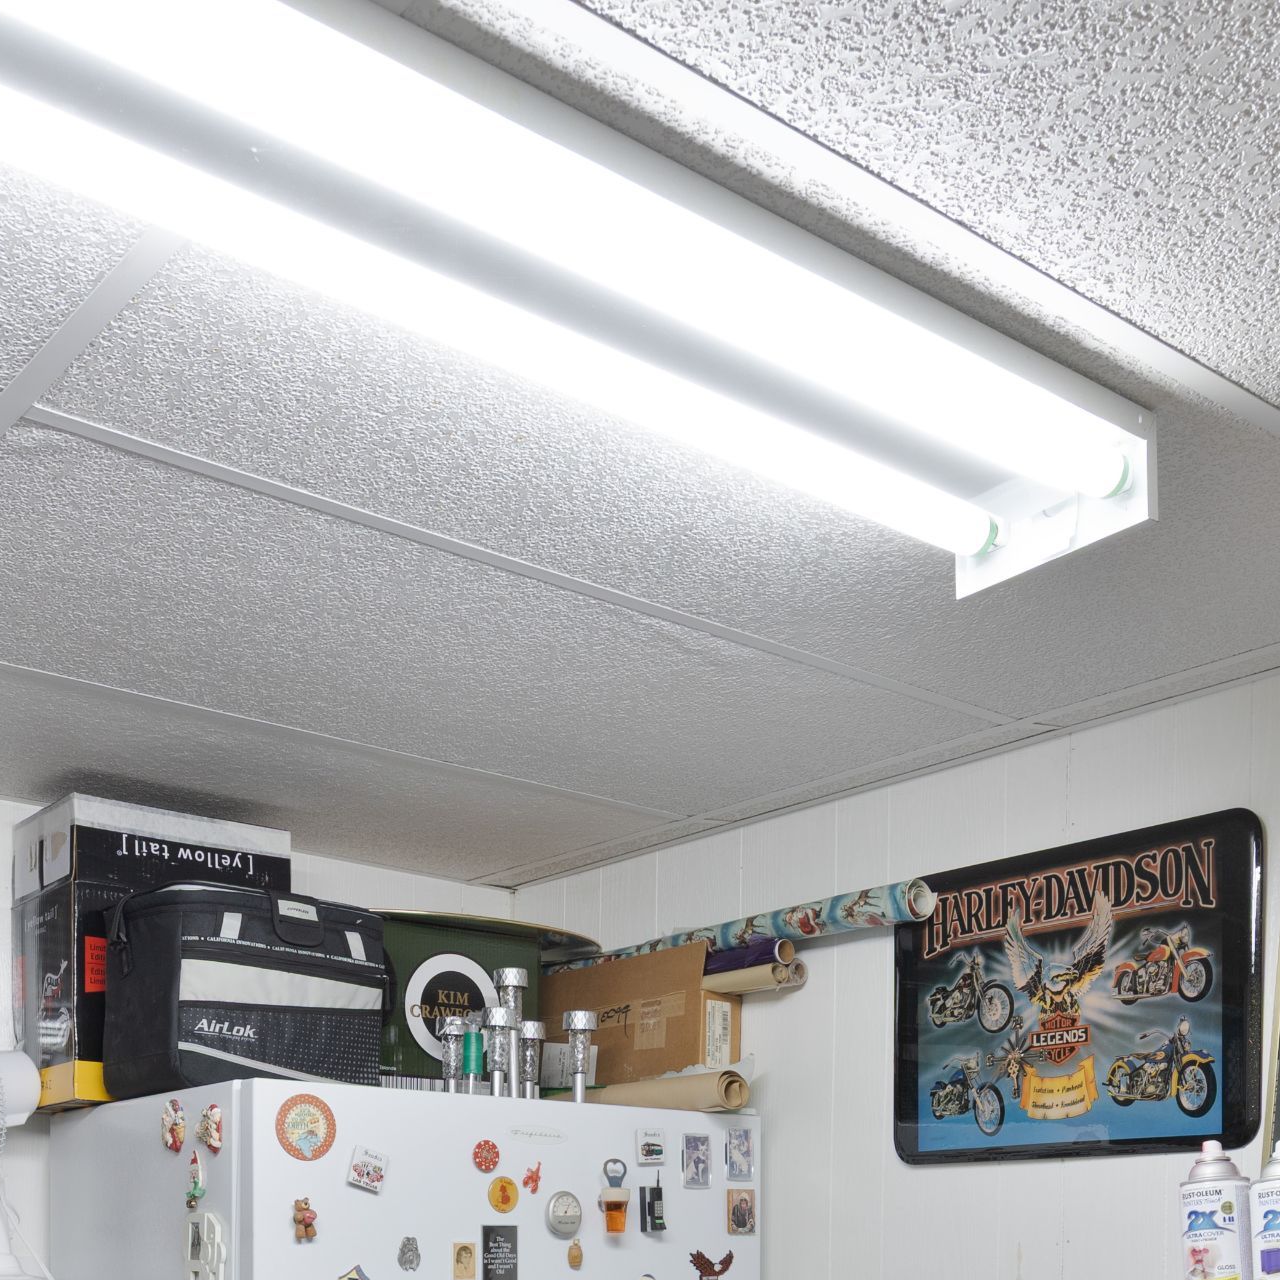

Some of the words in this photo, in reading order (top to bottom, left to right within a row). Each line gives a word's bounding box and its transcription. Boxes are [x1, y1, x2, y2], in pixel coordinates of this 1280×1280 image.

[924, 838, 1216, 959] HARLEY-DAVIDSON
[437, 990, 469, 1006] KIM
[194, 1018, 257, 1038] AirLok
[1045, 1018, 1073, 1030] MOTOR
[1033, 1029, 1086, 1047] LEGENDS
